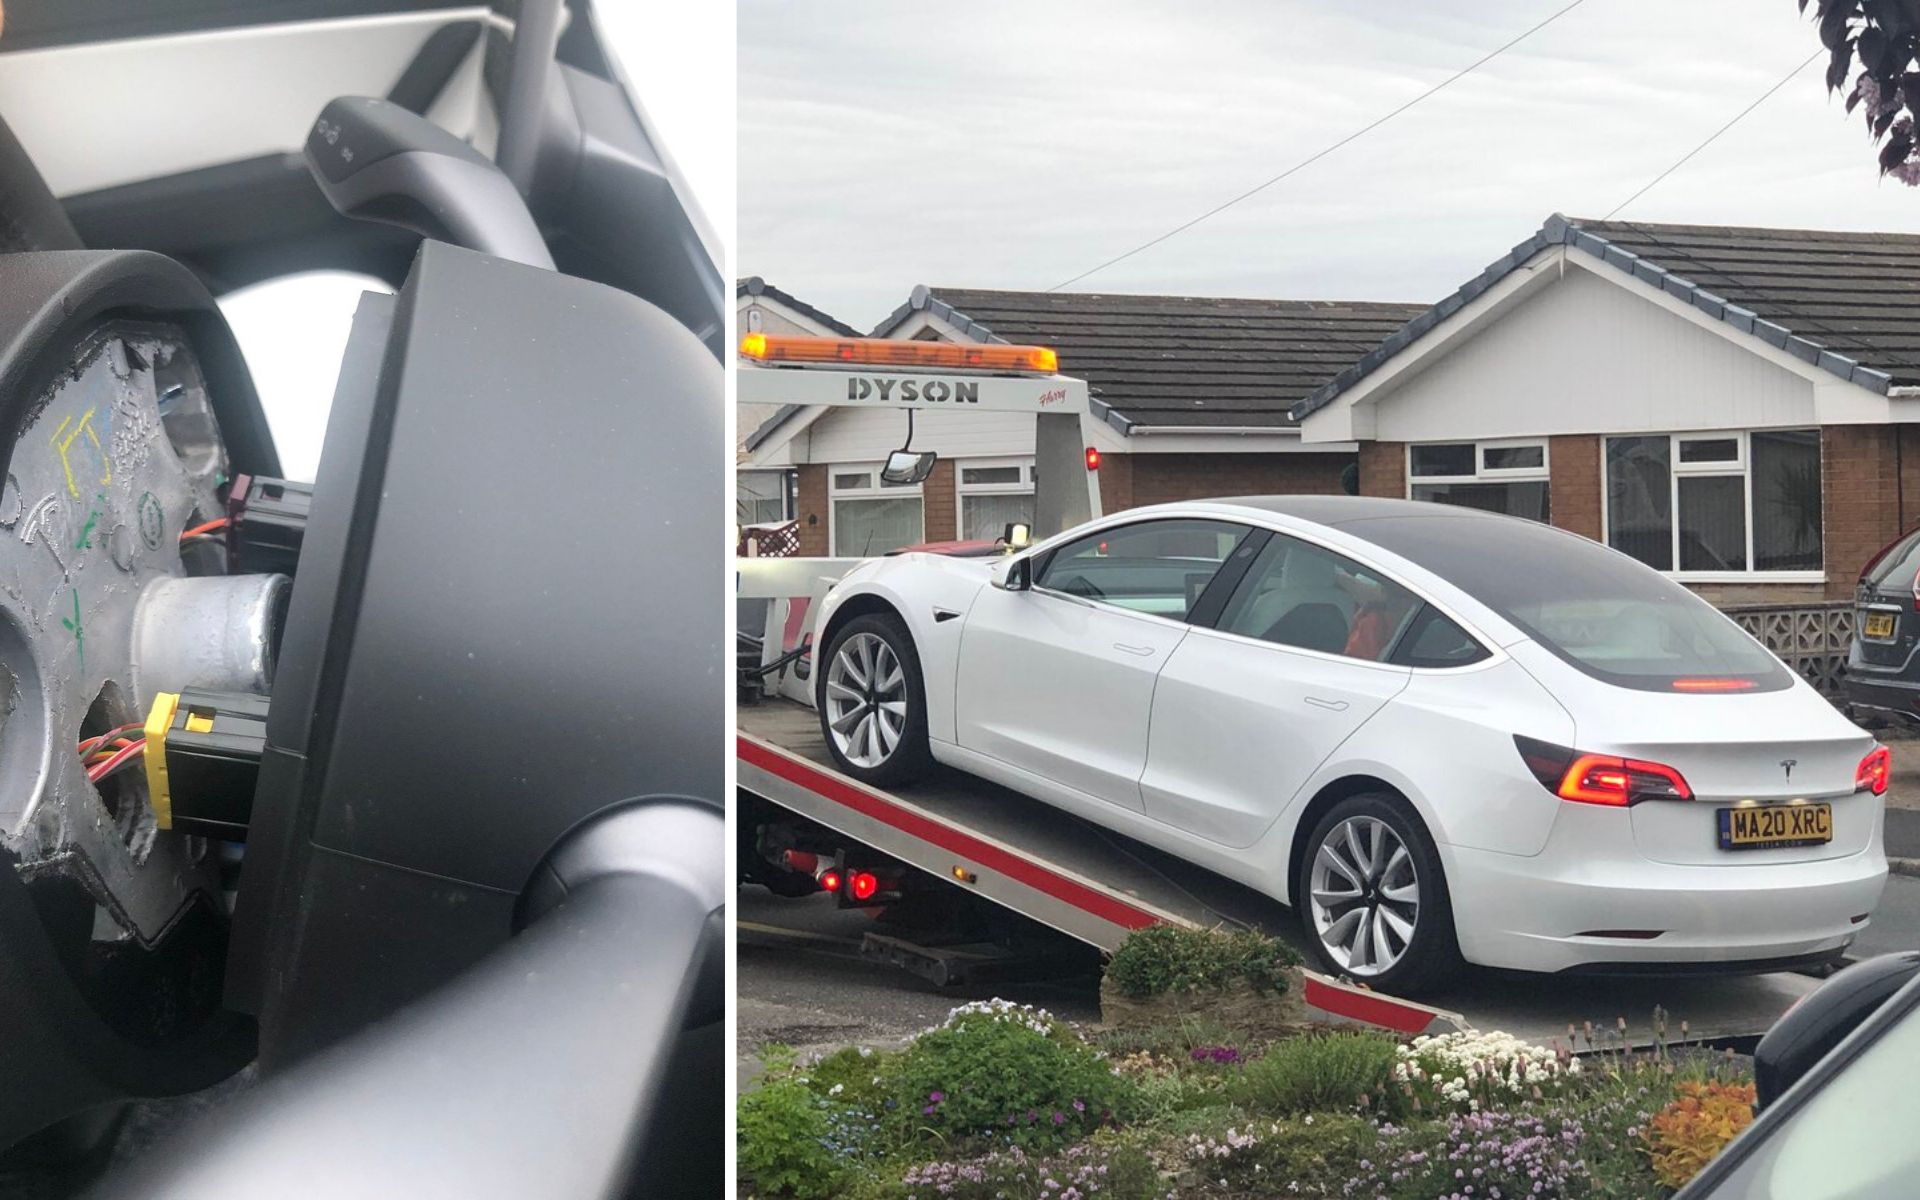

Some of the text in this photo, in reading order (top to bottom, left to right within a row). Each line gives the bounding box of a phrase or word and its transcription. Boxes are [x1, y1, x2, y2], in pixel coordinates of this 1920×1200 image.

[848, 377, 979, 403] DYSON
[1734, 807, 1827, 839] MA20 XRC
